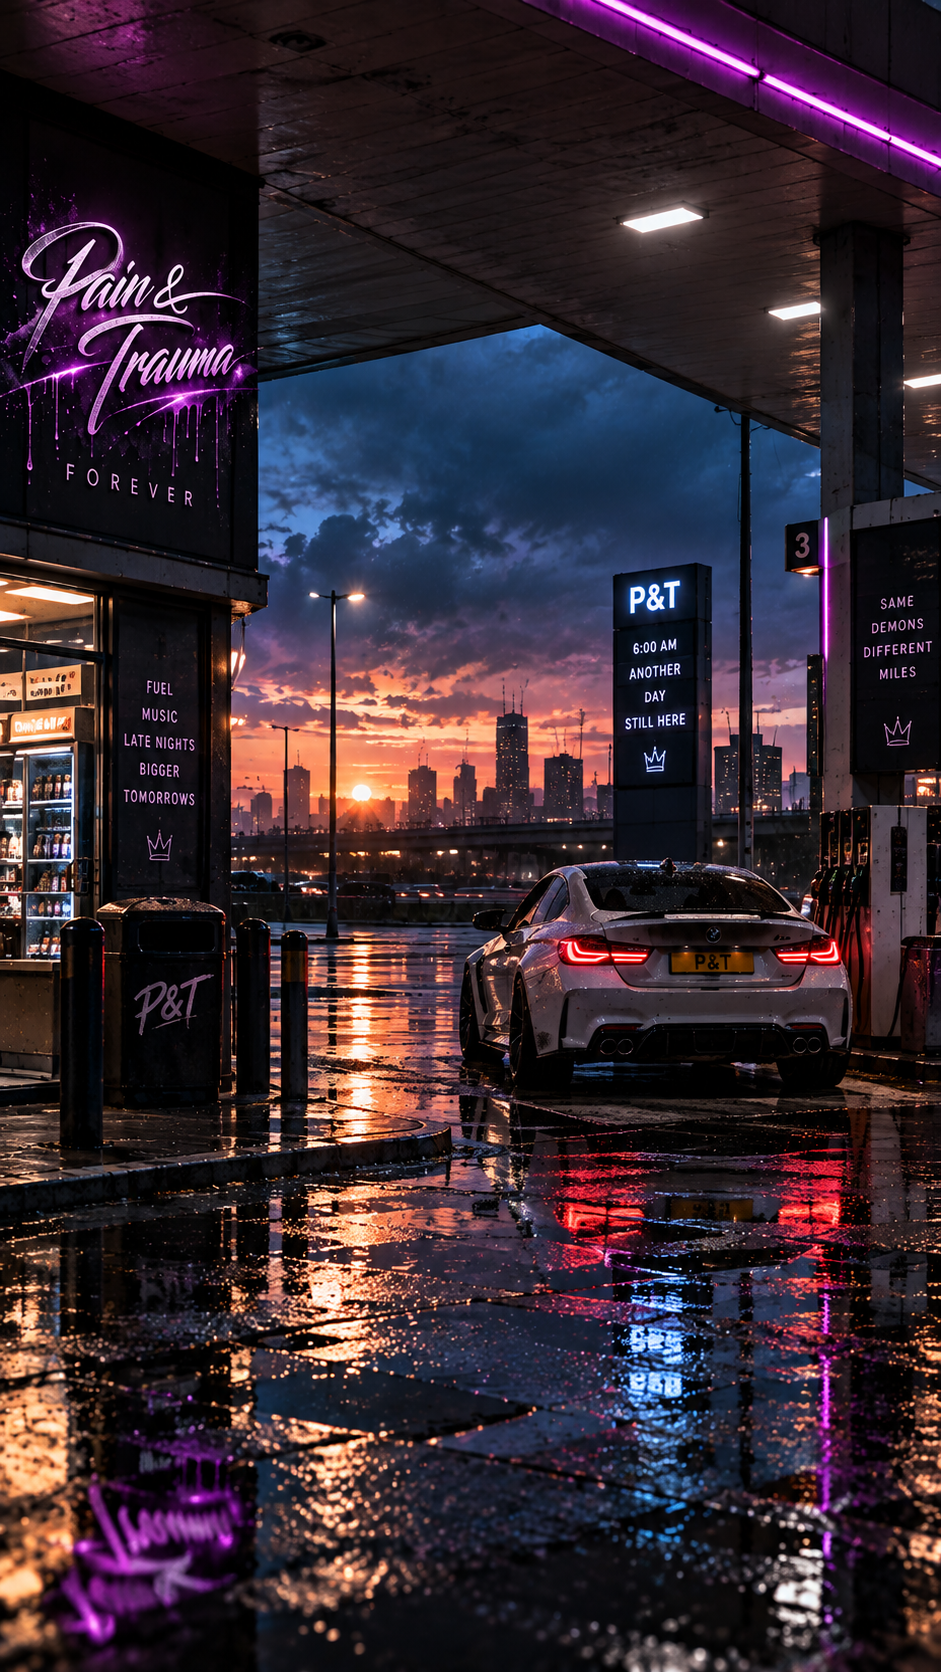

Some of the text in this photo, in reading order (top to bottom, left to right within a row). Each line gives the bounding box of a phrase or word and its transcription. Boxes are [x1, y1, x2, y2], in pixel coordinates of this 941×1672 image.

[22, 221, 248, 373] Pain &
[78, 313, 238, 435] Trauma
[66, 462, 194, 507] FOREVER
[795, 532, 811, 559] 3
[628, 580, 682, 614] P&T
[880, 594, 914, 610] SAME
[871, 617, 924, 634] DEMONS
[632, 638, 678, 655] 6:00 AM
[863, 640, 933, 658] DIFFERENT
[629, 663, 681, 680] ANOTHER
[879, 665, 917, 680] MILES
[146, 679, 174, 696] FUEL
[644, 690, 666, 703] DAY
[141, 707, 178, 724] MUSIC
[624, 712, 686, 731] STILL HERE
[124, 733, 196, 752] LATE NIGHTS
[139, 762, 180, 778] BIGGER
[123, 789, 195, 806] TOMORROWS
[695, 954, 731, 970] P&T
[134, 974, 214, 1035] P&T
